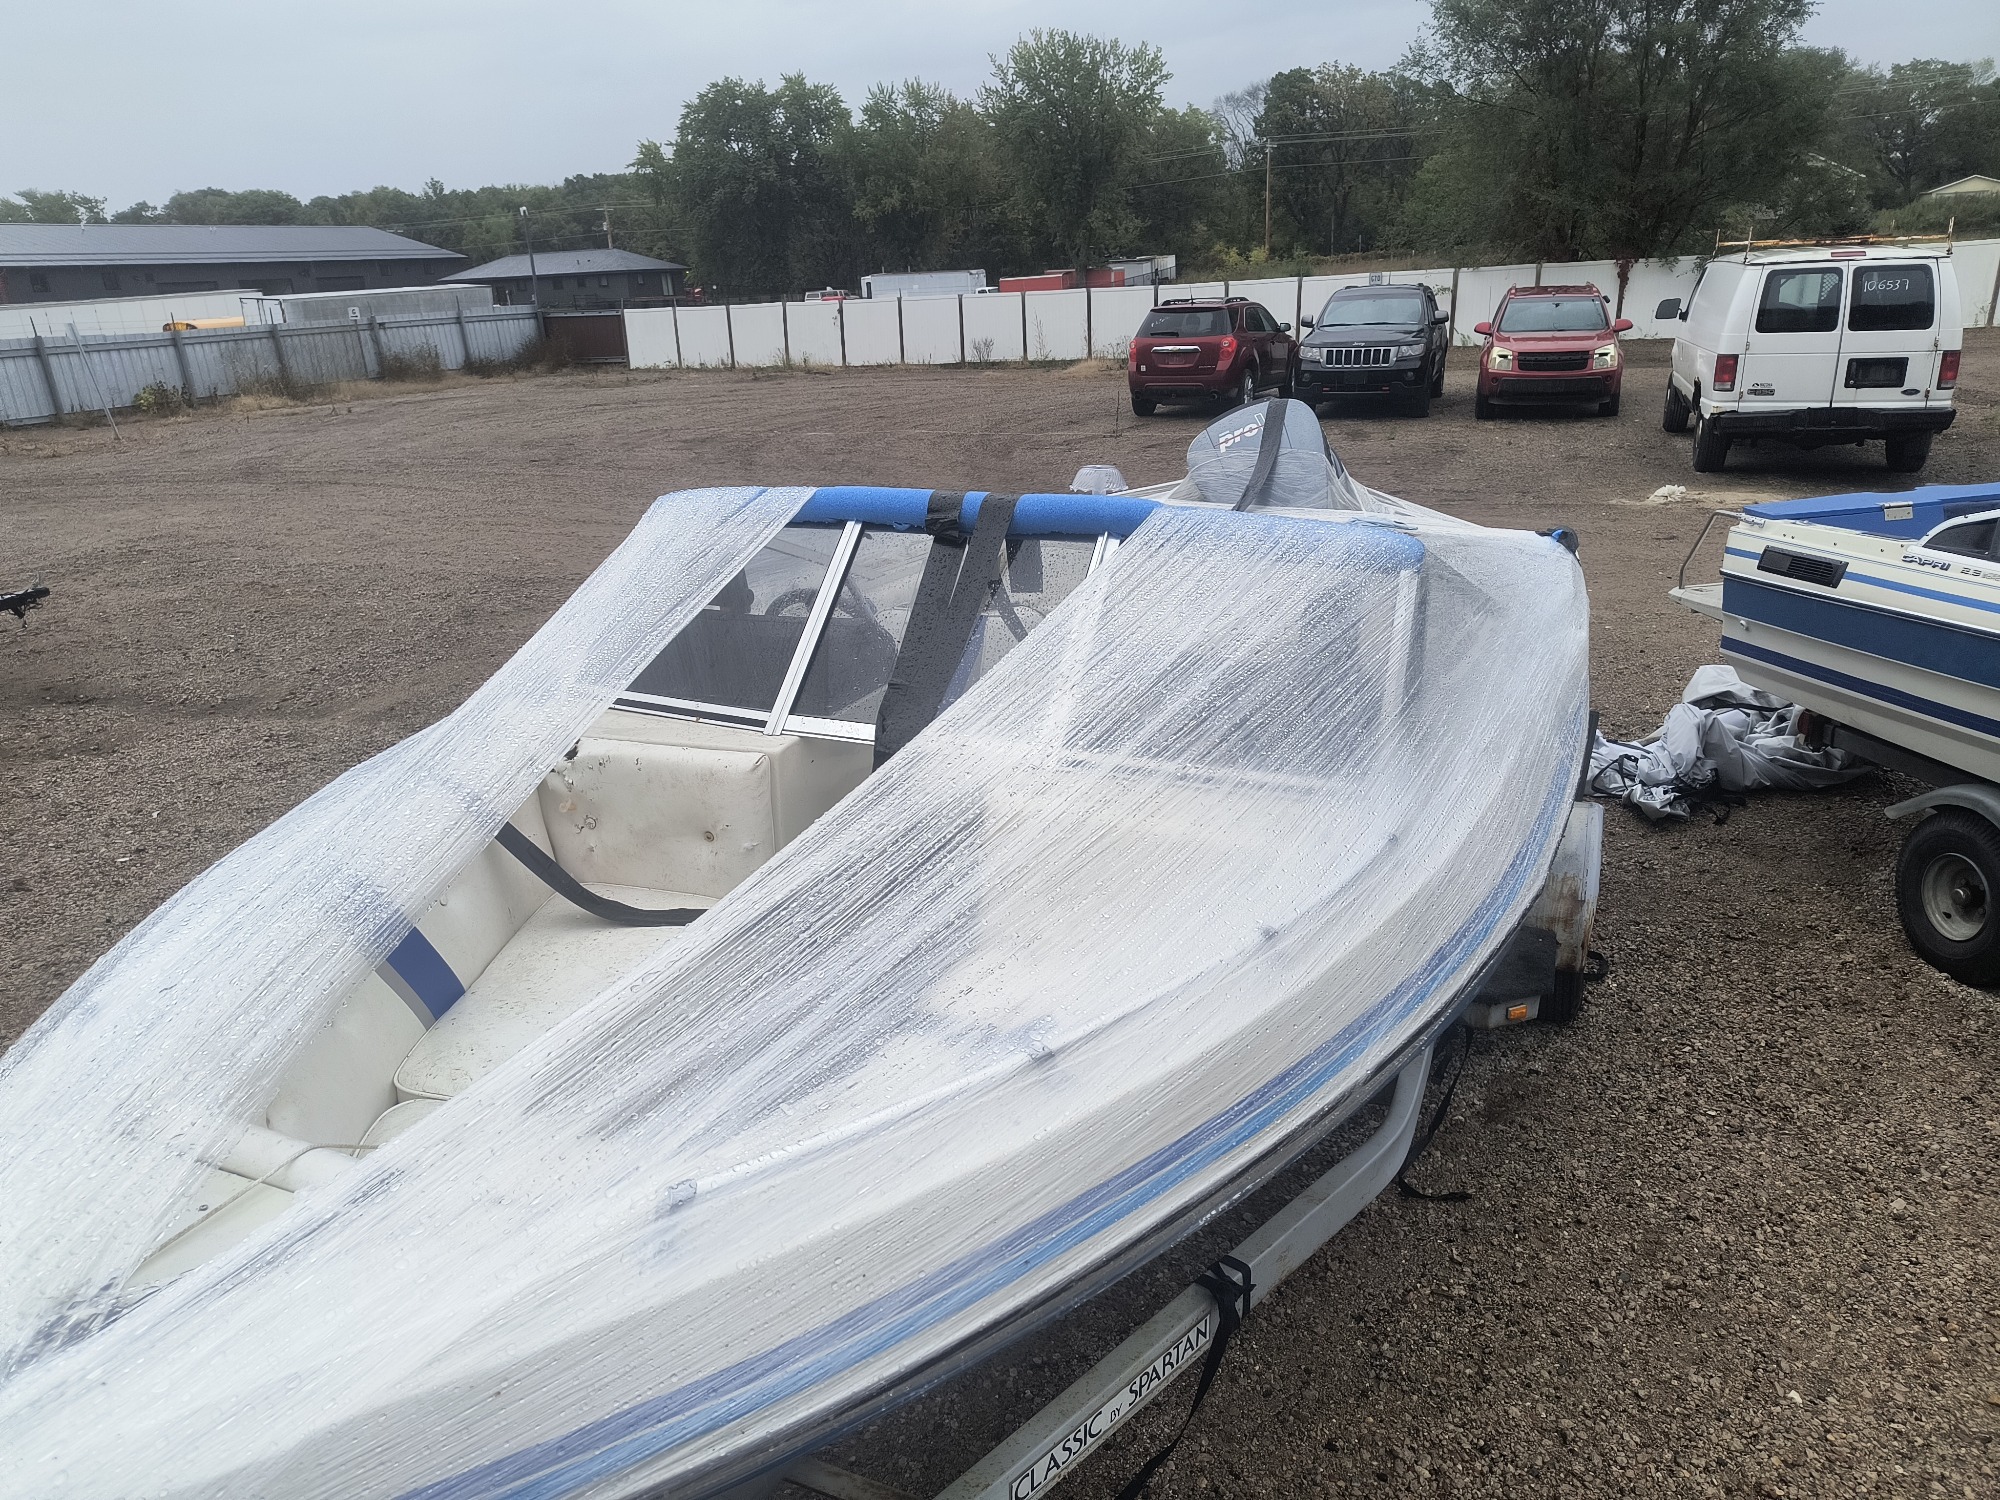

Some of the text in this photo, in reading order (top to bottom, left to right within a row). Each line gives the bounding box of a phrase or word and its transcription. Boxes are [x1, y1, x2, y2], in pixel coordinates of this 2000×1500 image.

[1864, 278, 1909, 292] 106537
[1901, 554, 1952, 571] CAPRI
[1014, 1318, 1208, 1500] CLASSIC BY SPARTAN
